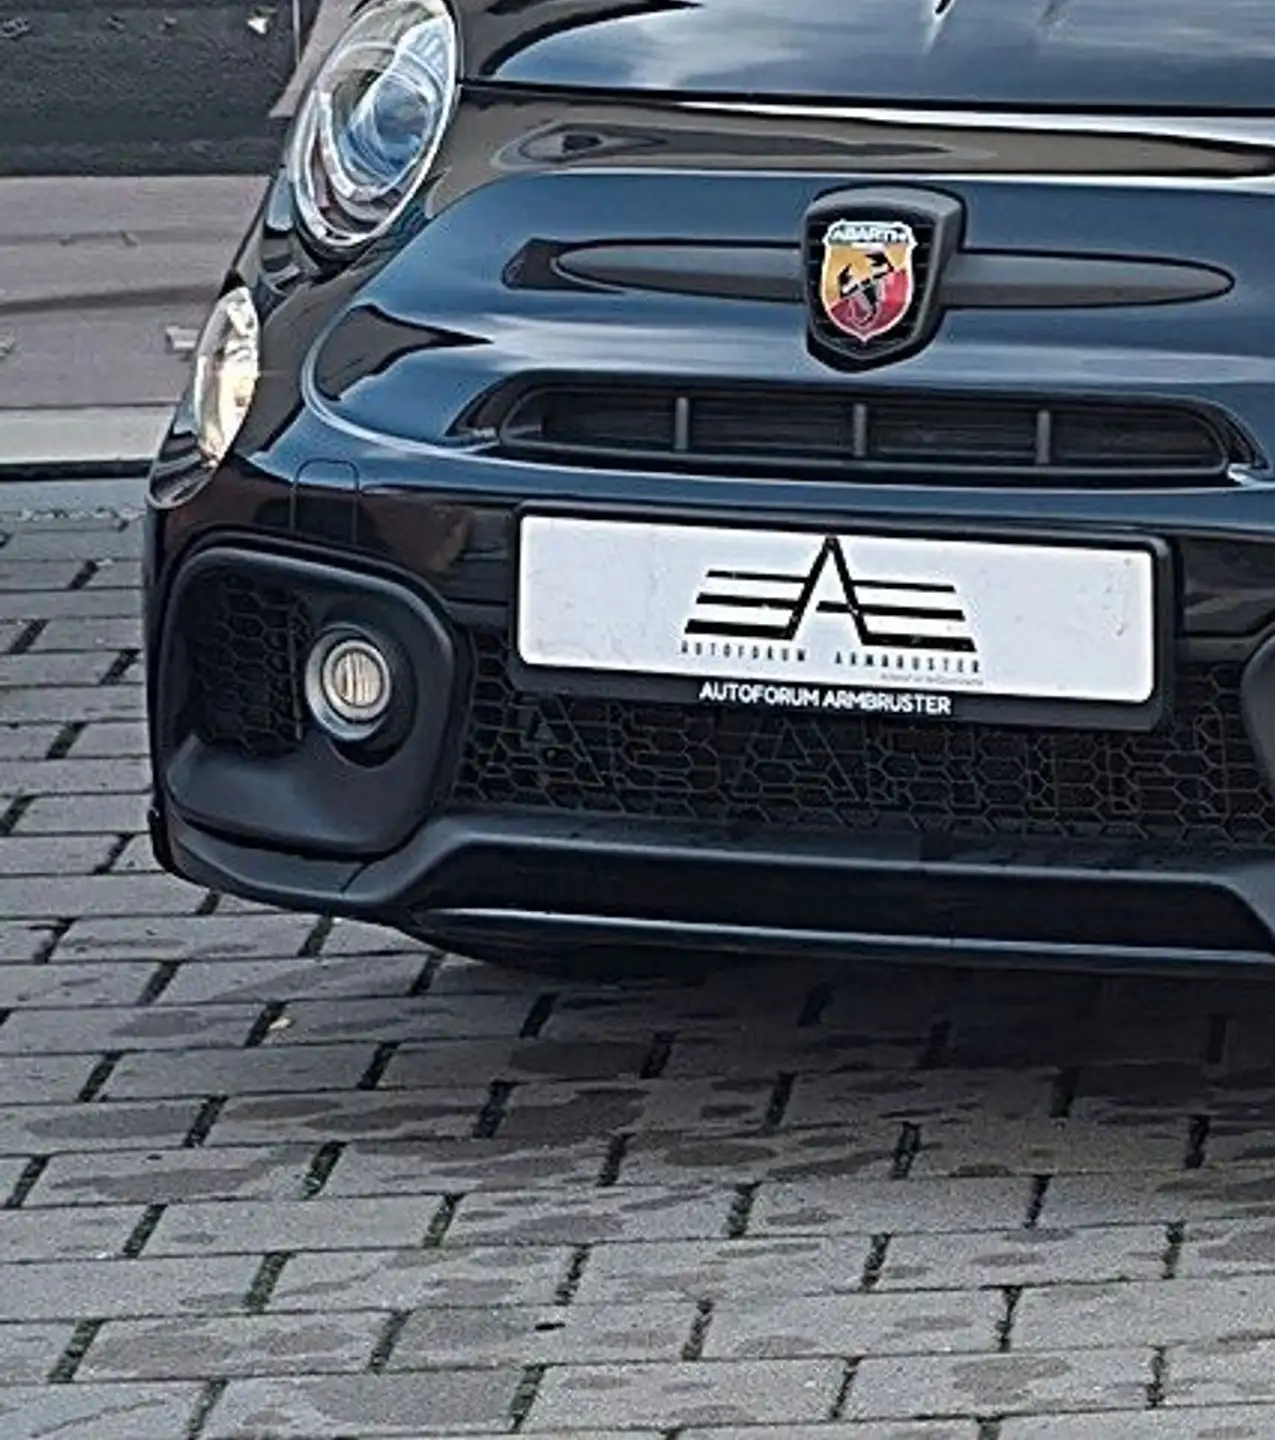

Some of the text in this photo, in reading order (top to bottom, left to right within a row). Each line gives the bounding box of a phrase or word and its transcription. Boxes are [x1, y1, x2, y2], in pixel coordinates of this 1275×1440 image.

[681, 640, 979, 674] AUTOFORUM ARMBRUSTER
[699, 681, 951, 715] AUTOFORUM ARMBRUSTER
